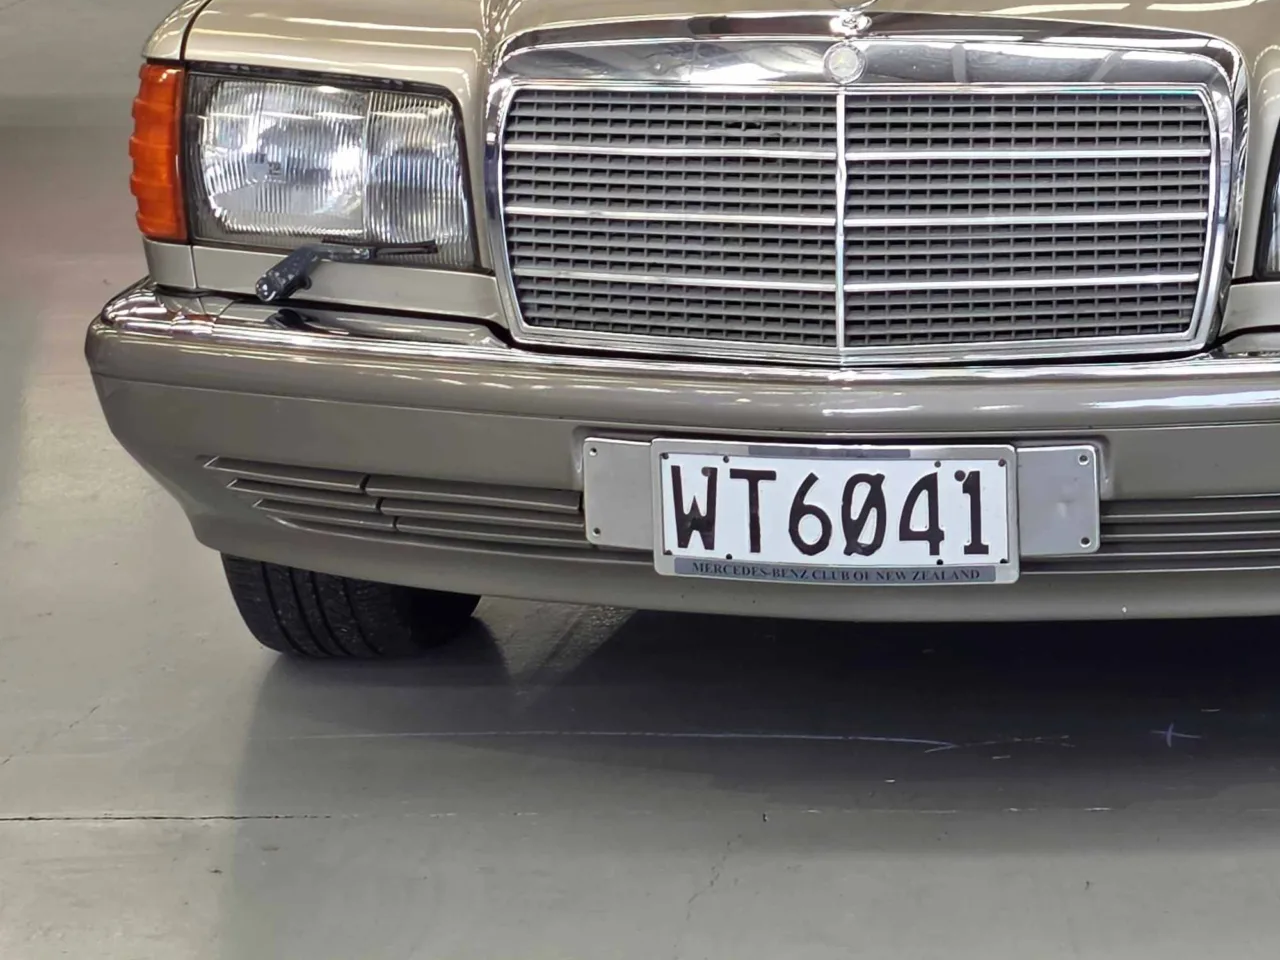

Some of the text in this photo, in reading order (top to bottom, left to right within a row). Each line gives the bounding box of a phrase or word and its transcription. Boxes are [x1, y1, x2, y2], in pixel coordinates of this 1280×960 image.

[670, 464, 990, 557] WT6041
[692, 562, 980, 582] MERCEDES-BENZ CLUB OF NEW ZEALAND
